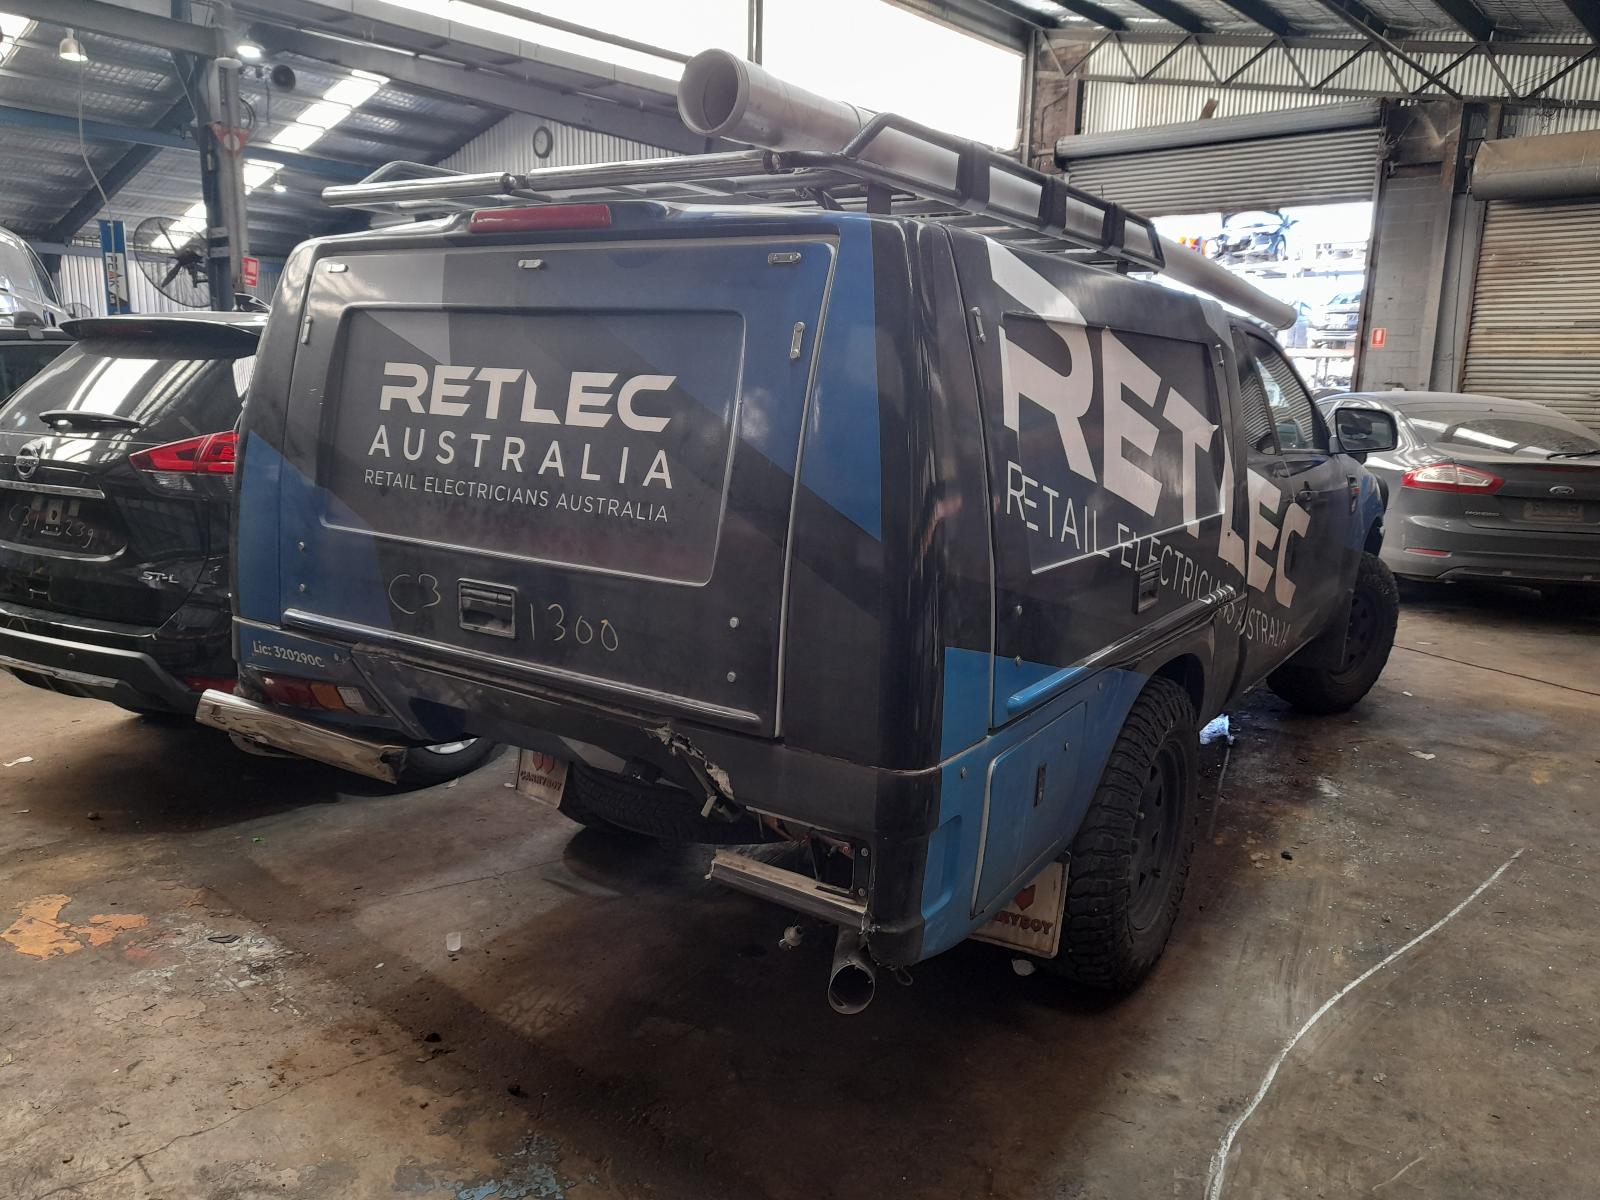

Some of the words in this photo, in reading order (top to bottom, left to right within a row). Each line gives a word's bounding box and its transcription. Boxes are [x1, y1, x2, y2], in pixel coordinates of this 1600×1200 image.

[379, 361, 678, 433] RETLEC
[984, 238, 1312, 609] RETLEC
[368, 424, 673, 490] AUSTRALIA
[364, 468, 418, 490] RETAIL
[424, 476, 549, 507] ELECTRICIANS
[556, 493, 669, 523] AUSTRALIA
[1006, 460, 1110, 558] RETAIL
[141, 571, 180, 584] ST-L
[388, 573, 441, 615] C3
[530, 603, 619, 651] 1300
[252, 639, 272, 656] Lic:
[273, 645, 326, 668] 320290C
